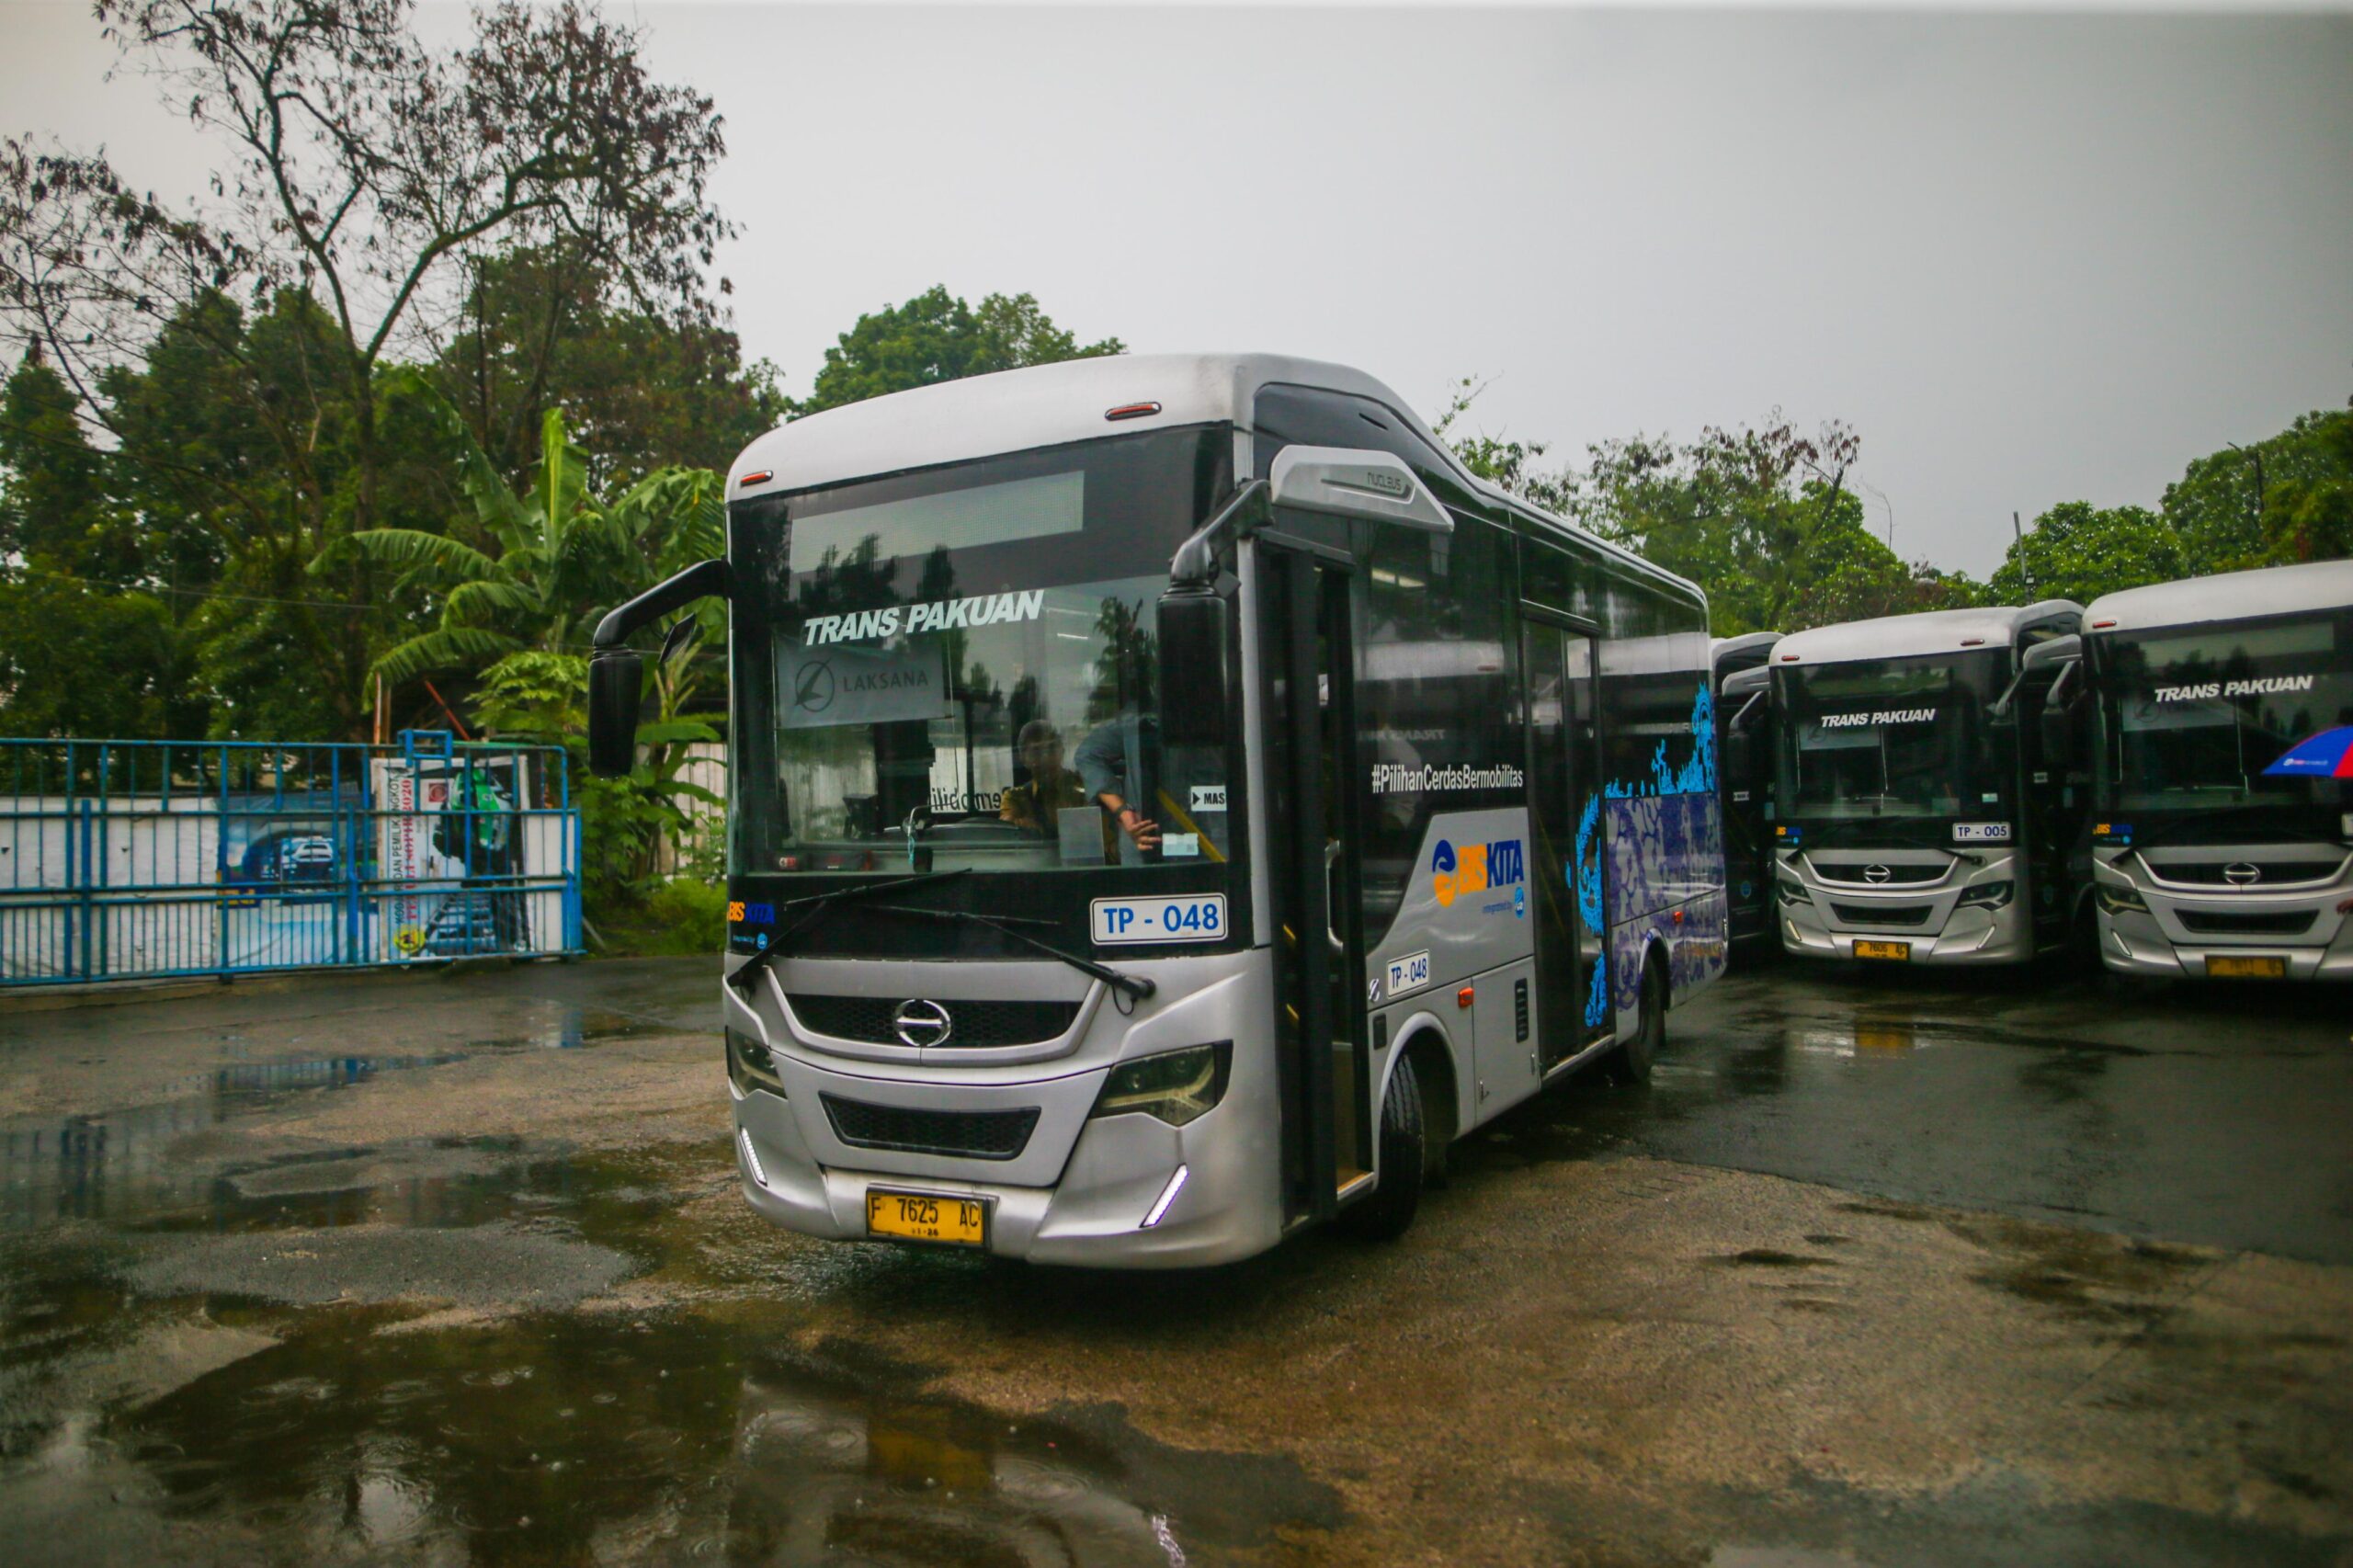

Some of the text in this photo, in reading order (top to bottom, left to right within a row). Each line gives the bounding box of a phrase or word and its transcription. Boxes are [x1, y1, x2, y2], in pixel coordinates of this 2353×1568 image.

[805, 589, 1045, 646] TRANS PAKUAN
[843, 669, 929, 692] LAKSANA
[2154, 676, 2314, 702] TRANS PAKUAN
[1821, 709, 1936, 728] TRANS PAKUAN
[1371, 763, 1523, 794] #PilihanCerdasBermobilitas
[1958, 826, 1971, 837] TP
[1984, 825, 2007, 836] 005
[1103, 907, 1134, 933] TP
[1163, 903, 1220, 932] 048
[1391, 966, 1402, 989] TP
[1410, 958, 1427, 983] 048
[870, 1197, 979, 1227] F 7625 AC
